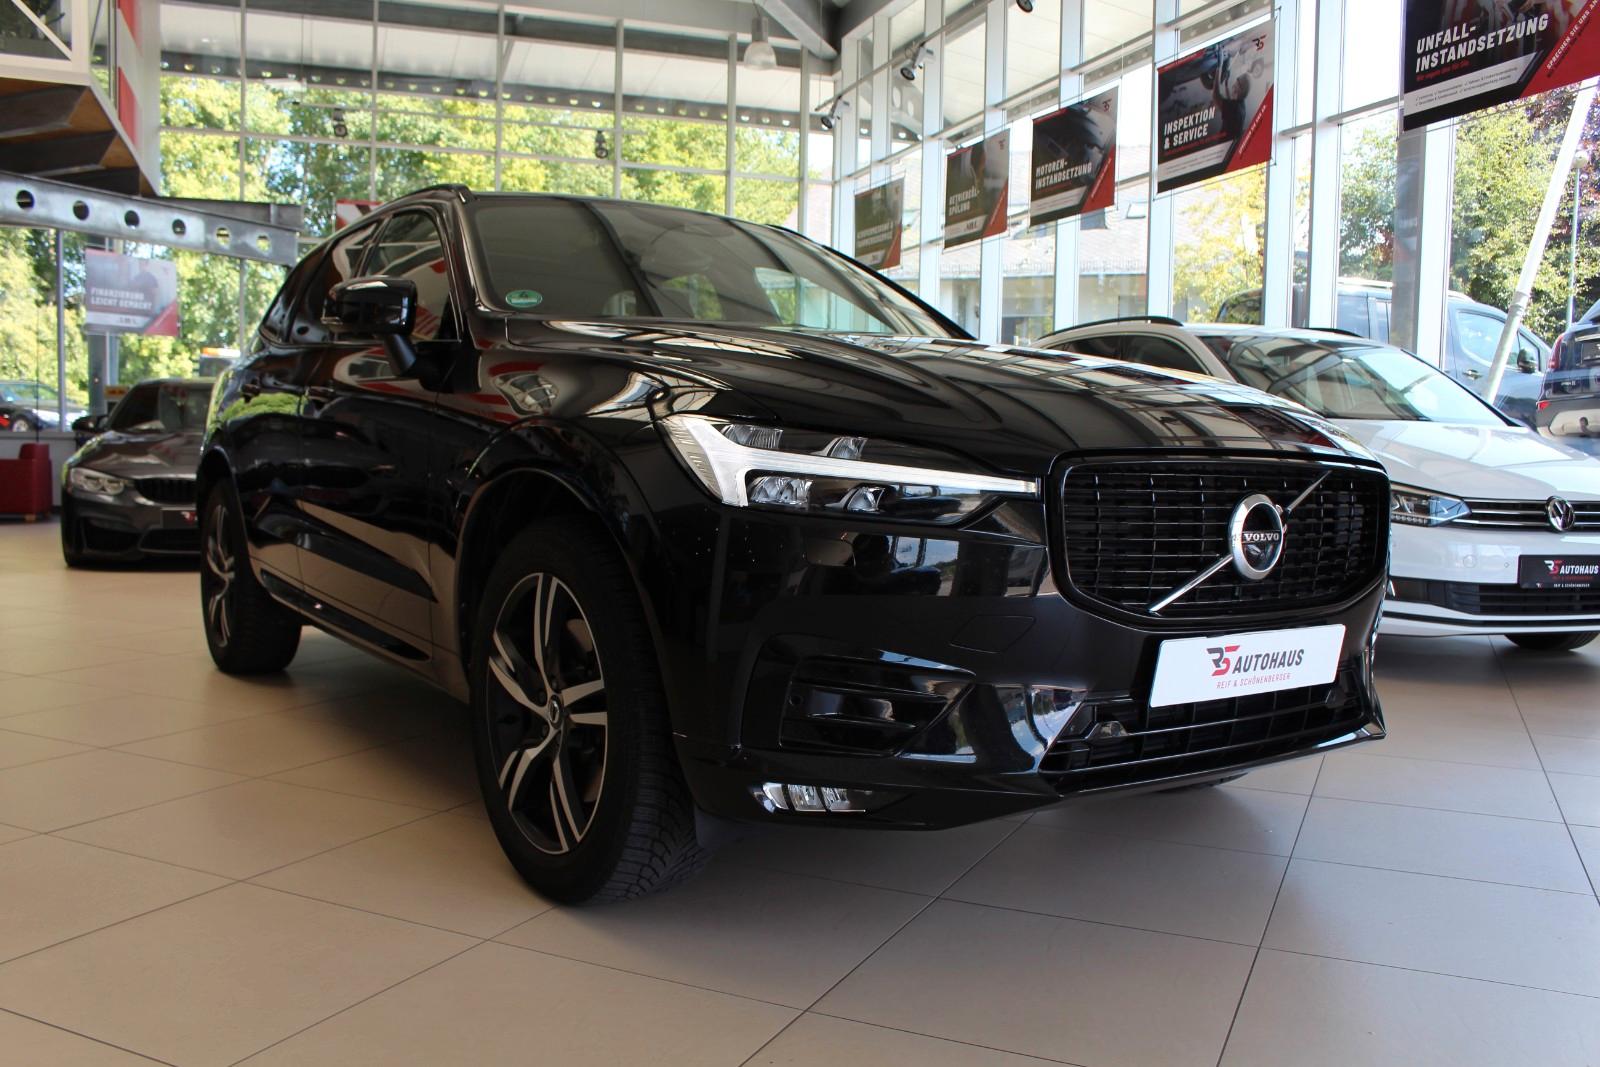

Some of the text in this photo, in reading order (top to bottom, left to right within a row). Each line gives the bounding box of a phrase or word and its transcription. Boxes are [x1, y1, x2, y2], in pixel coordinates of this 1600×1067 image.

[1415, 13, 1549, 73] INSTANDSETZUNG
[1417, 22, 1476, 54] UNFALL-
[1164, 106, 1216, 136] INSPEKTION
[1164, 137, 1170, 149] &
[1173, 123, 1209, 147] SERVICE
[1035, 162, 1092, 190] INSTANDSETZUNG
[1036, 158, 1068, 178] MOTOREN-
[91, 287, 145, 300] FINANZIERUNG
[91, 296, 118, 307] LEICHT
[119, 299, 152, 310] GEMACHT
[1244, 533, 1279, 542] VOLVO
[1560, 565, 1599, 575] AUTOHAUS
[1232, 648, 1305, 675] AUTOHAUS
[1216, 680, 1232, 689] REIF
[1239, 672, 1291, 686] SCHÖNENBERGER
